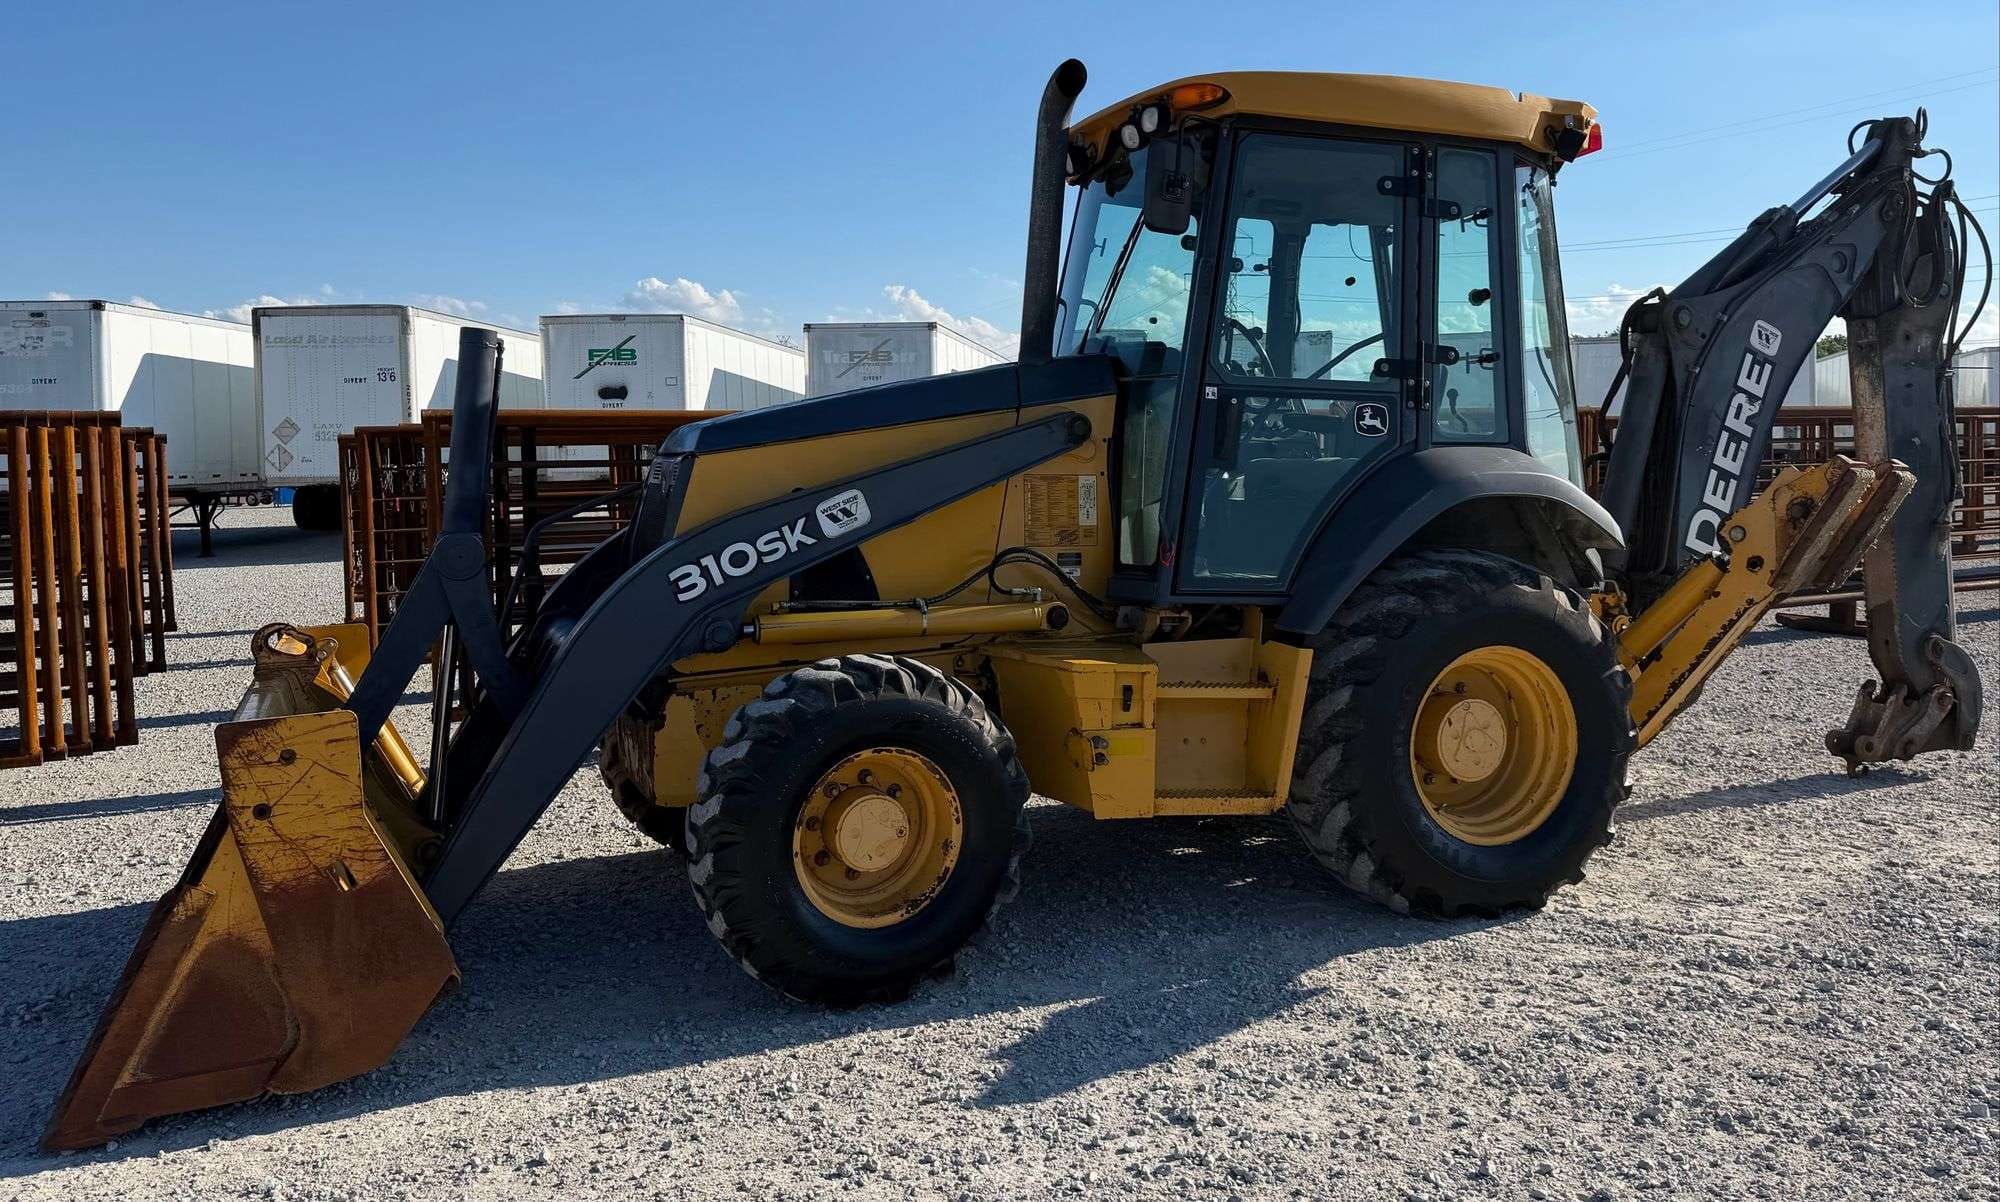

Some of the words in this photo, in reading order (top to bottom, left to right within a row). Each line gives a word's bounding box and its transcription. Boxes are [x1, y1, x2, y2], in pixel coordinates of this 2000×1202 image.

[588, 348, 637, 361] FAB
[1685, 351, 1773, 556] DEERE
[820, 501, 841, 514] WEST
[841, 494, 859, 506] SIDE
[667, 516, 818, 602] 310SK
